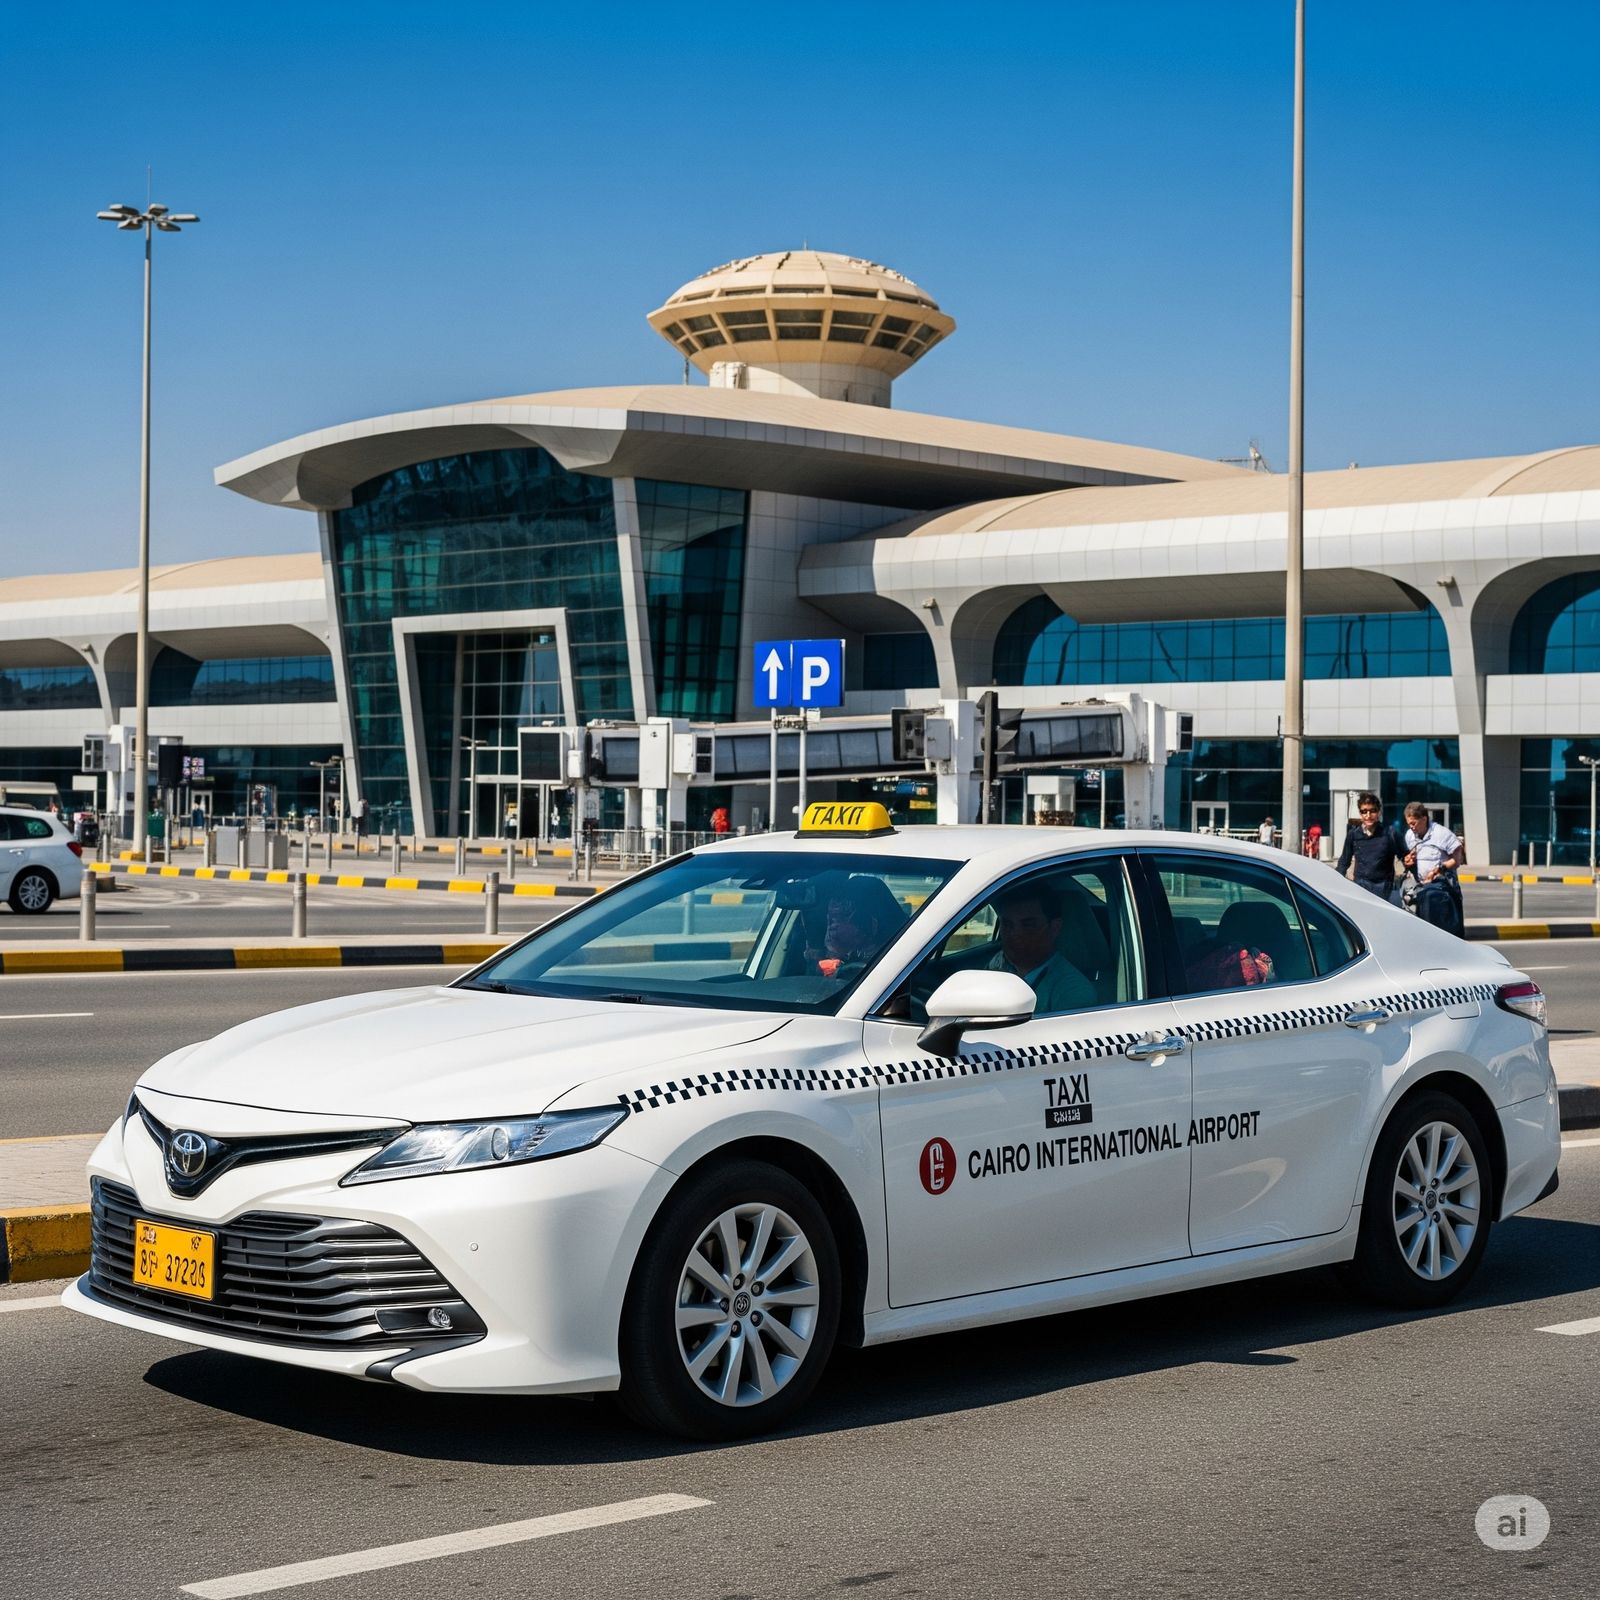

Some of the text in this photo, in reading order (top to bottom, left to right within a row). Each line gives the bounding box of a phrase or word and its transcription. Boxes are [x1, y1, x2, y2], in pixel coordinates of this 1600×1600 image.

[802, 656, 830, 700] P
[1043, 1073, 1090, 1107] TAXI
[968, 1110, 1260, 1179] CAIRO INTERNATIONAL AIRPORT
